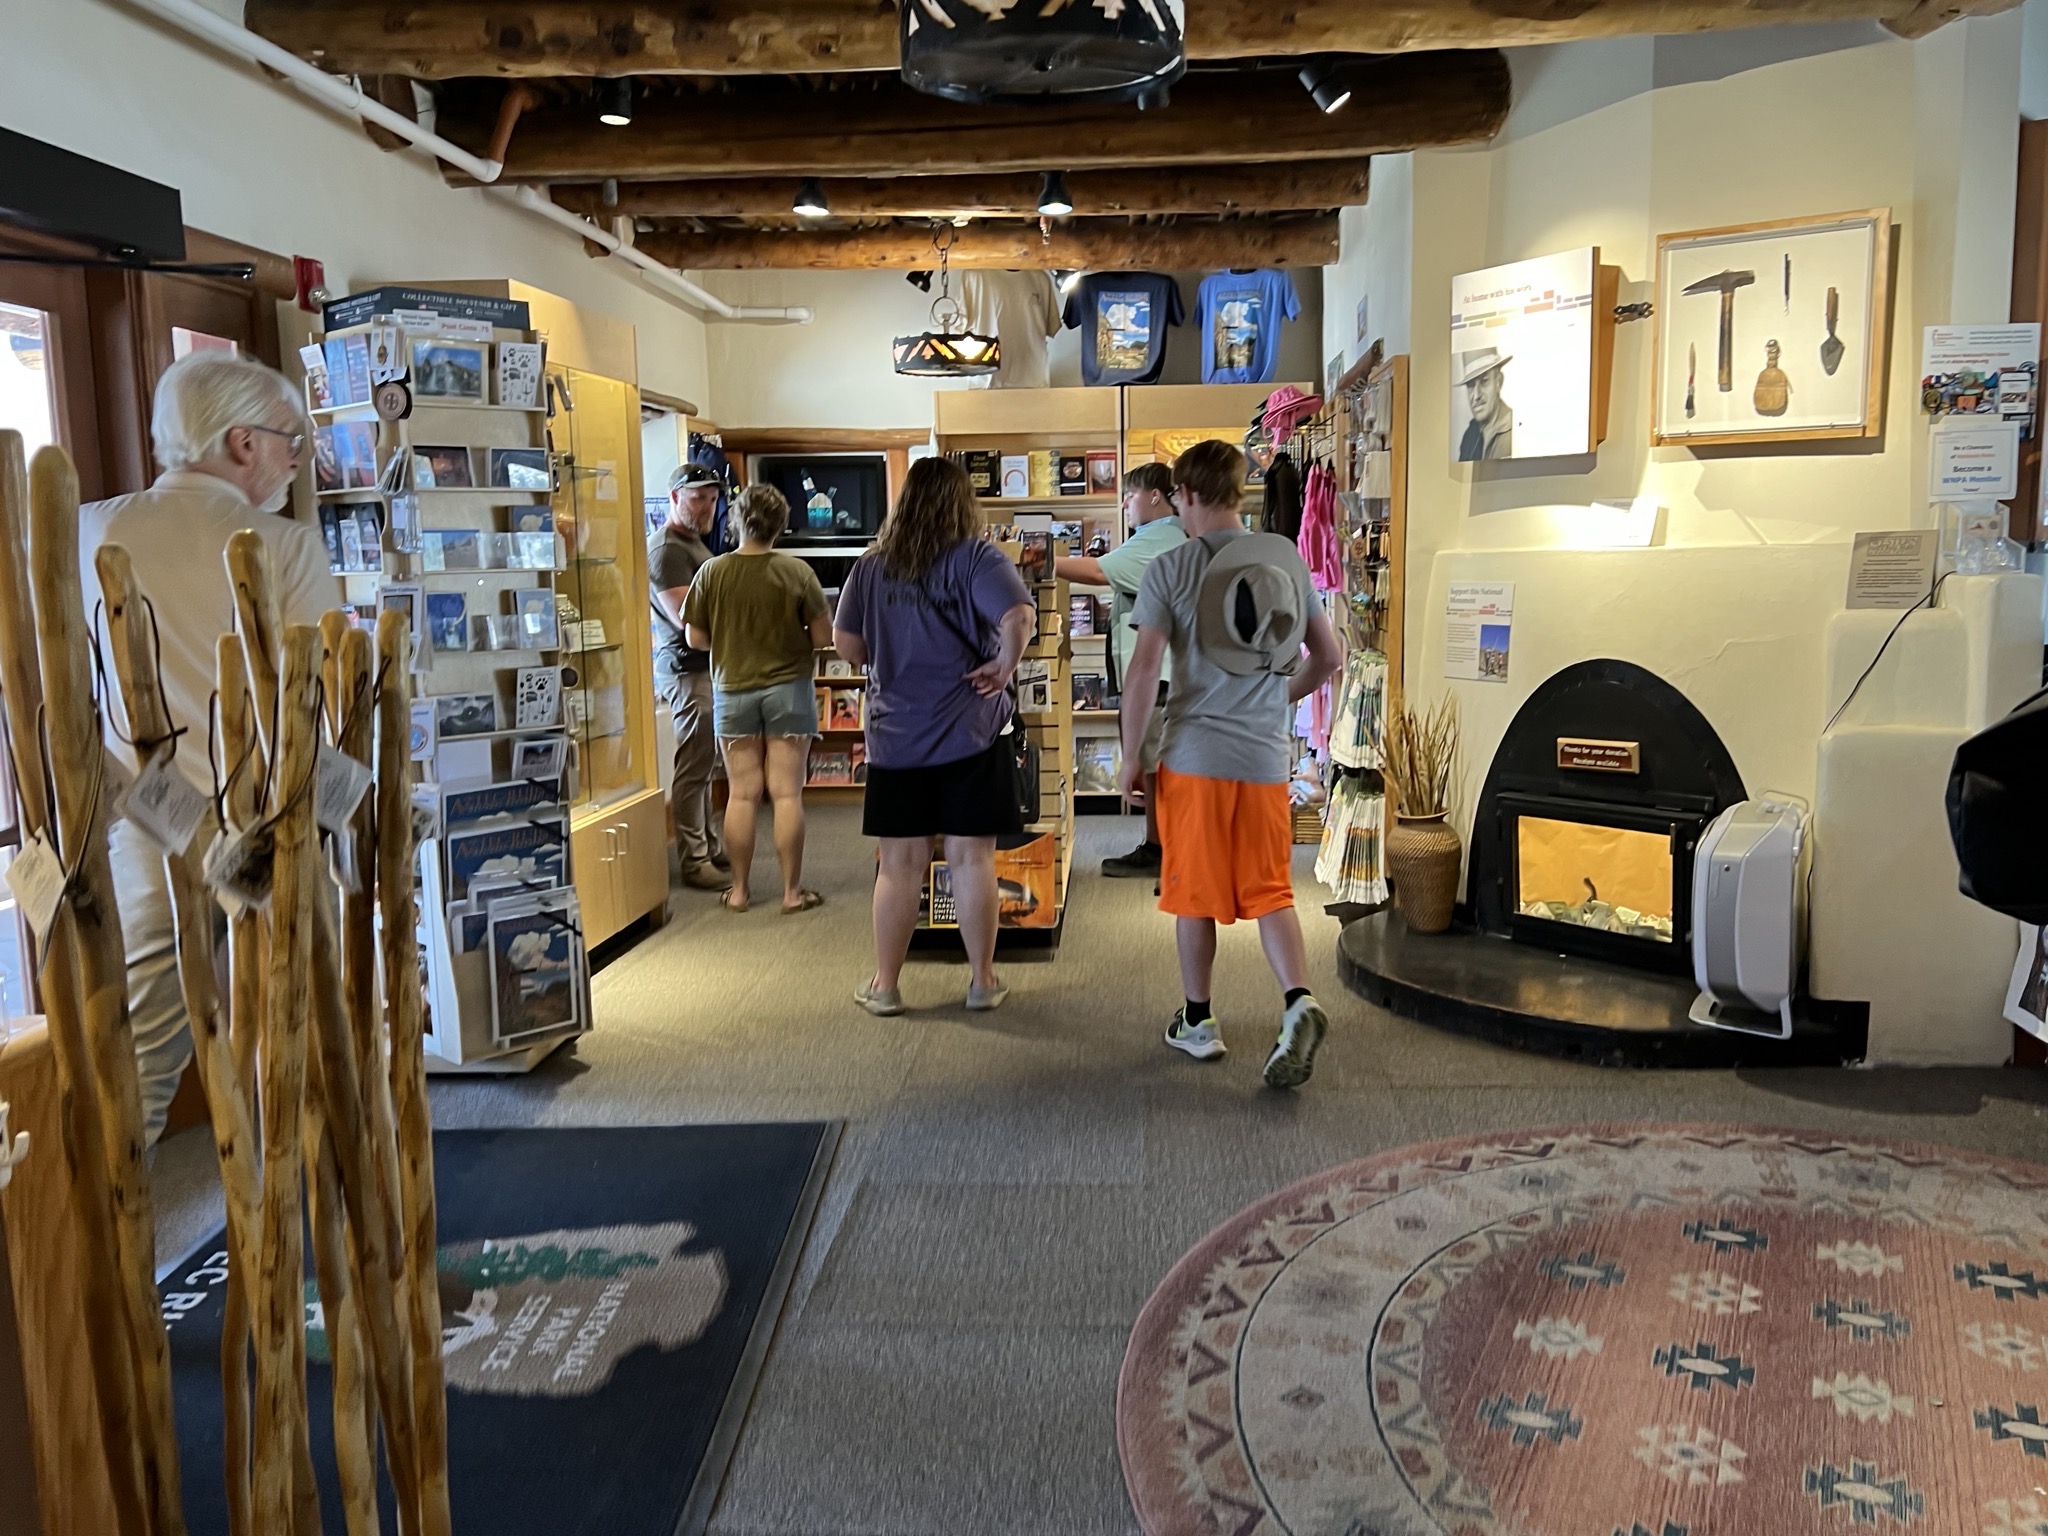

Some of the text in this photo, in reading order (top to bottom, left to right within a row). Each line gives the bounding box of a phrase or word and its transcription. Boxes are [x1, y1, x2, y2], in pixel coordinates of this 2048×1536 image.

[1450, 587, 1469, 597] Support
[480, 1295, 553, 1372] SERVICE
[528, 1307, 582, 1357] PARK
[553, 1281, 632, 1383] NATIONAL
